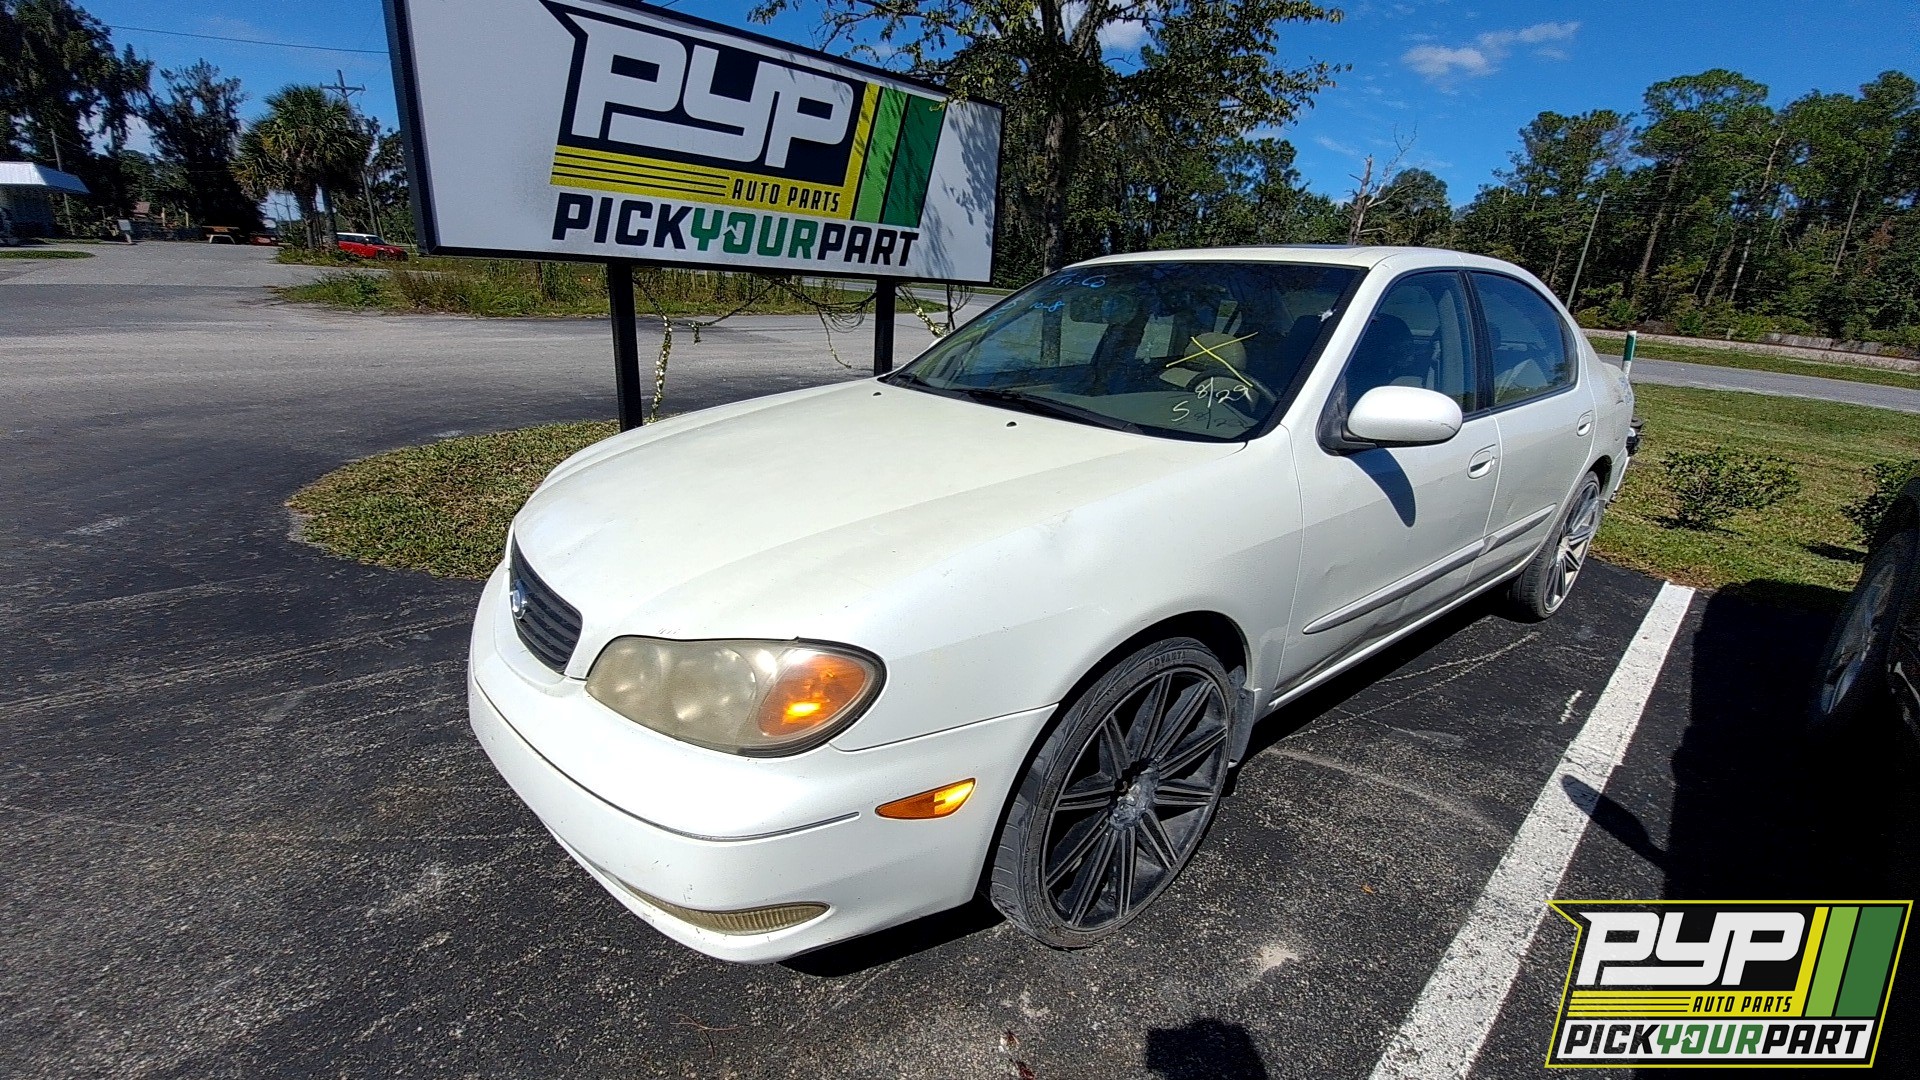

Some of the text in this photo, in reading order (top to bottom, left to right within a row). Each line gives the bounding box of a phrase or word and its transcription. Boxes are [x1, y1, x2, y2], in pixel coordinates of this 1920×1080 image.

[565, 12, 854, 168] PYP
[732, 179, 840, 212] AUTO PARTS
